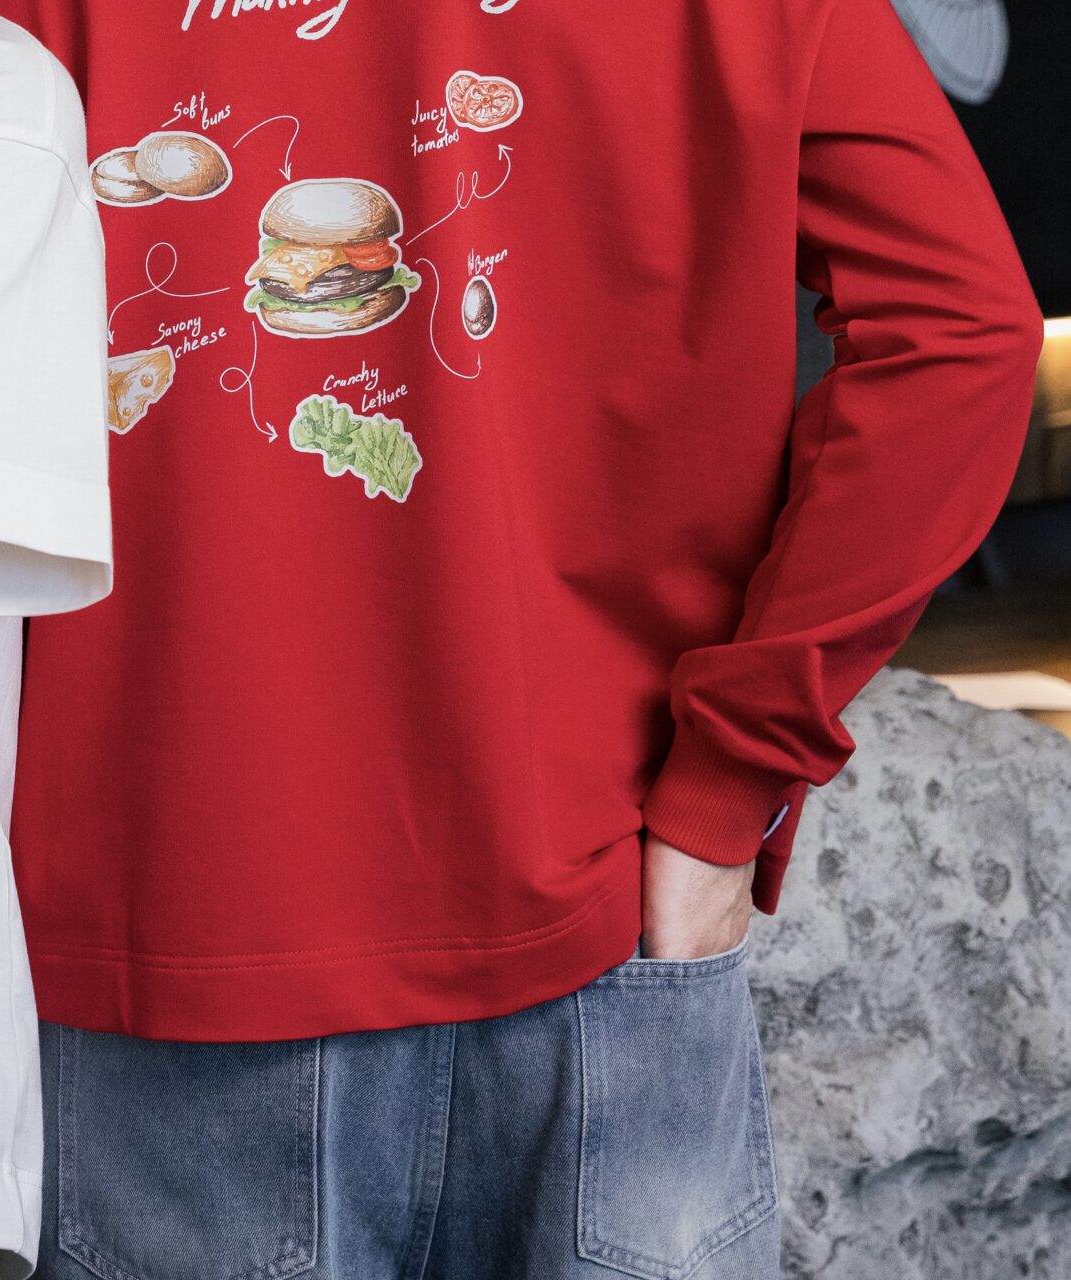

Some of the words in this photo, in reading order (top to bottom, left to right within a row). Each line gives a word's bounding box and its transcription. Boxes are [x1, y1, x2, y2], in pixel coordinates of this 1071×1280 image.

[161, 90, 206, 128] Soft
[201, 106, 231, 131] buns
[411, 99, 447, 134] Juicy
[150, 316, 202, 346] Savory
[174, 327, 227, 359] cheese
[322, 360, 379, 392] Crunchy
